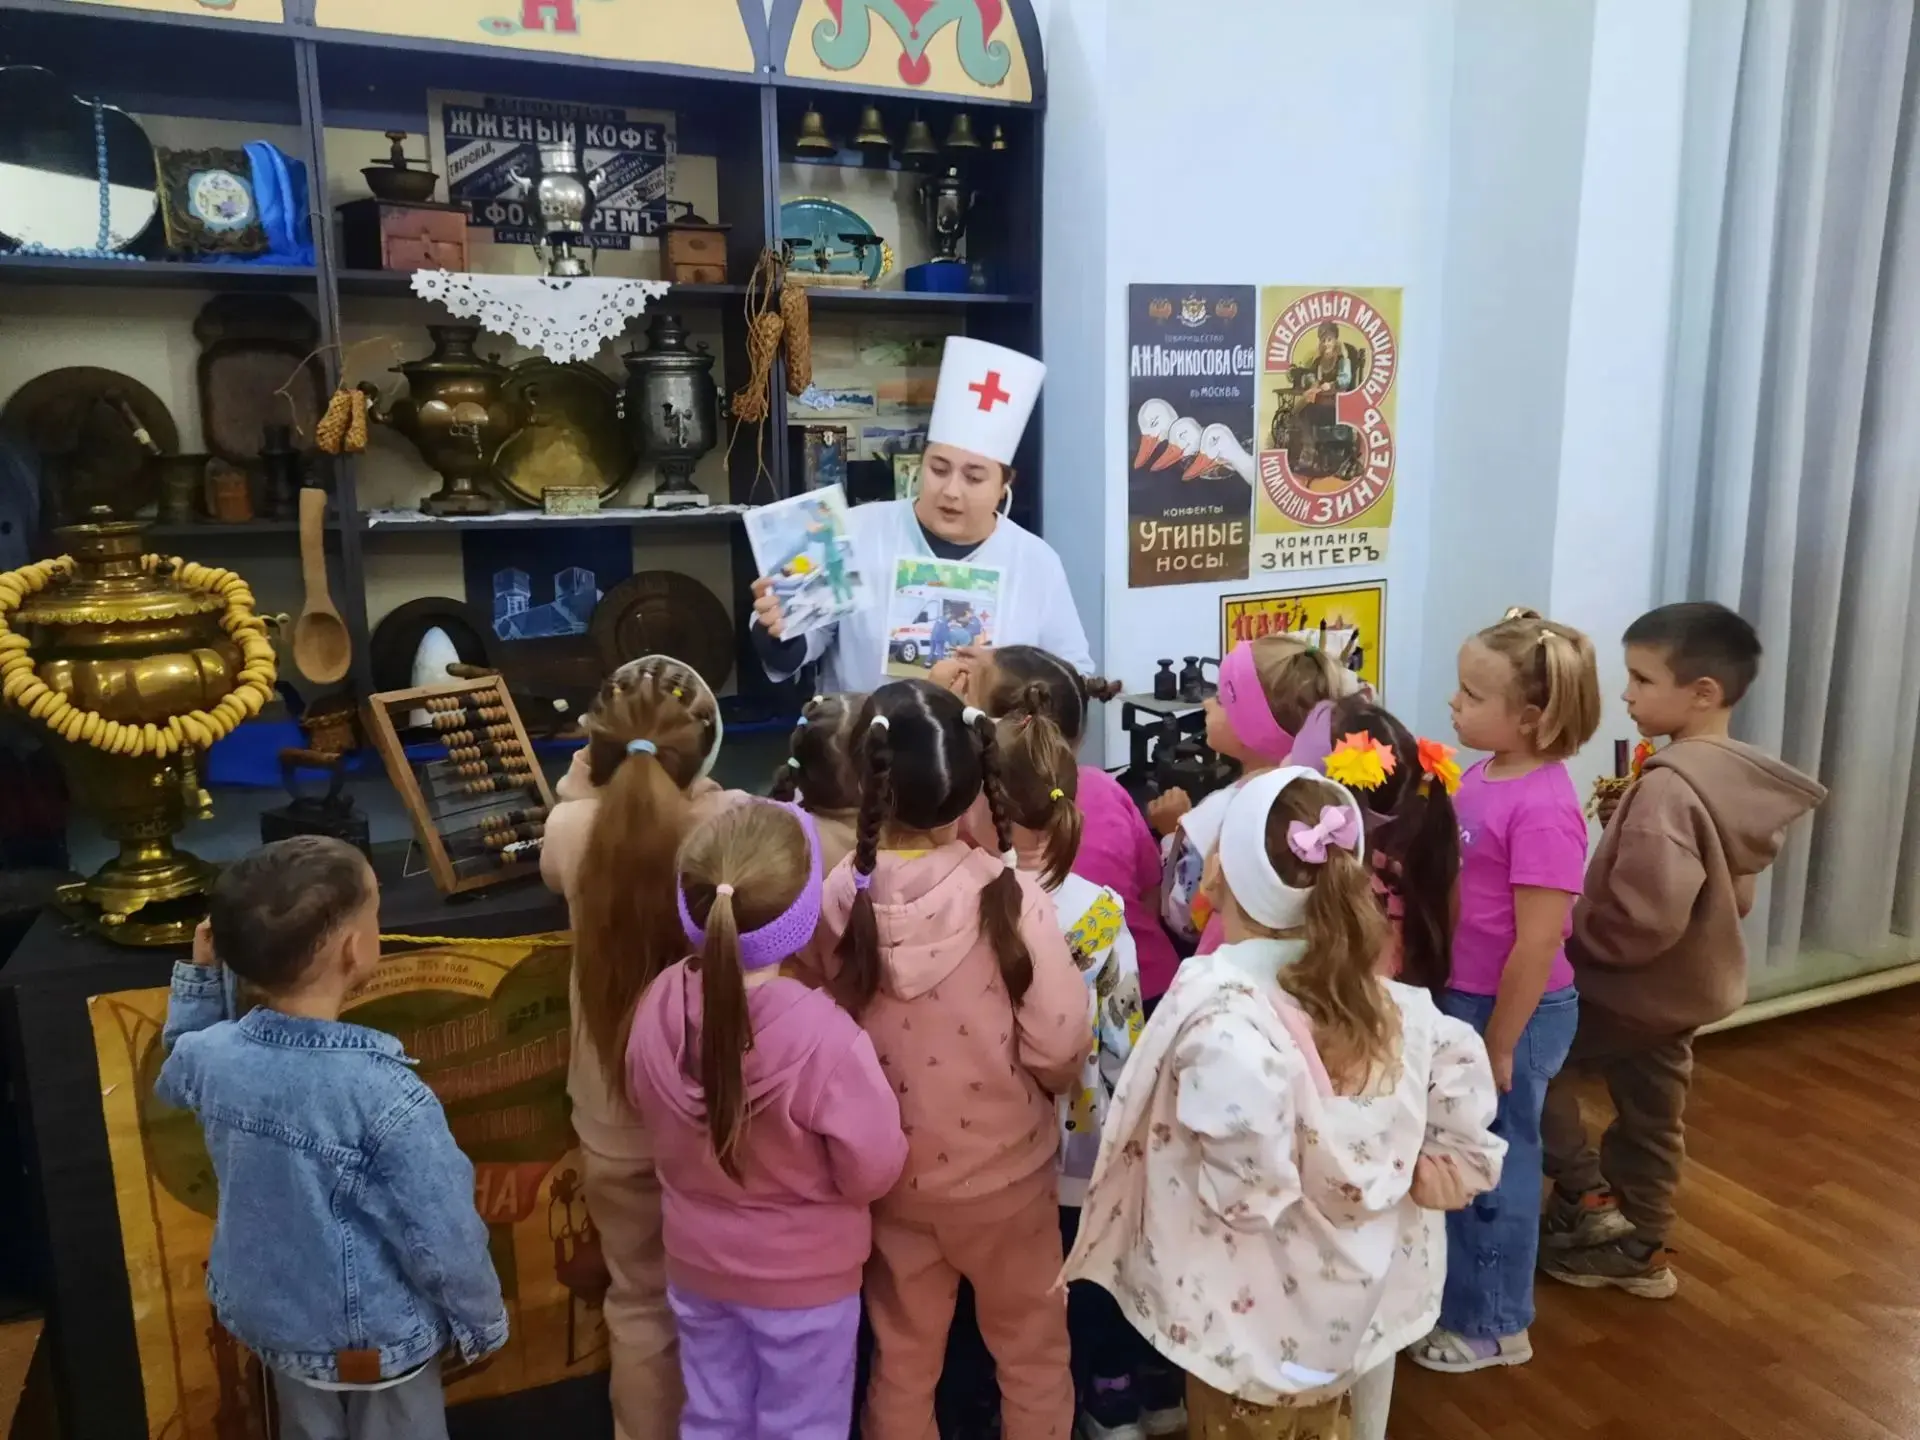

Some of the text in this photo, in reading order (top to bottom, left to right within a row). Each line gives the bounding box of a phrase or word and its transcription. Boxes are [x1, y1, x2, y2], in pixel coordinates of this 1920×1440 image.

[585, 123, 658, 151] КОФЕ
[1353, 303, 1393, 406] МАШИНЫ
[1163, 504, 1224, 517] КОНФЕКТЫ
[1139, 520, 1243, 553] УТИНЫЕ
[1260, 545, 1380, 570] ЗИНГЕРЪ
